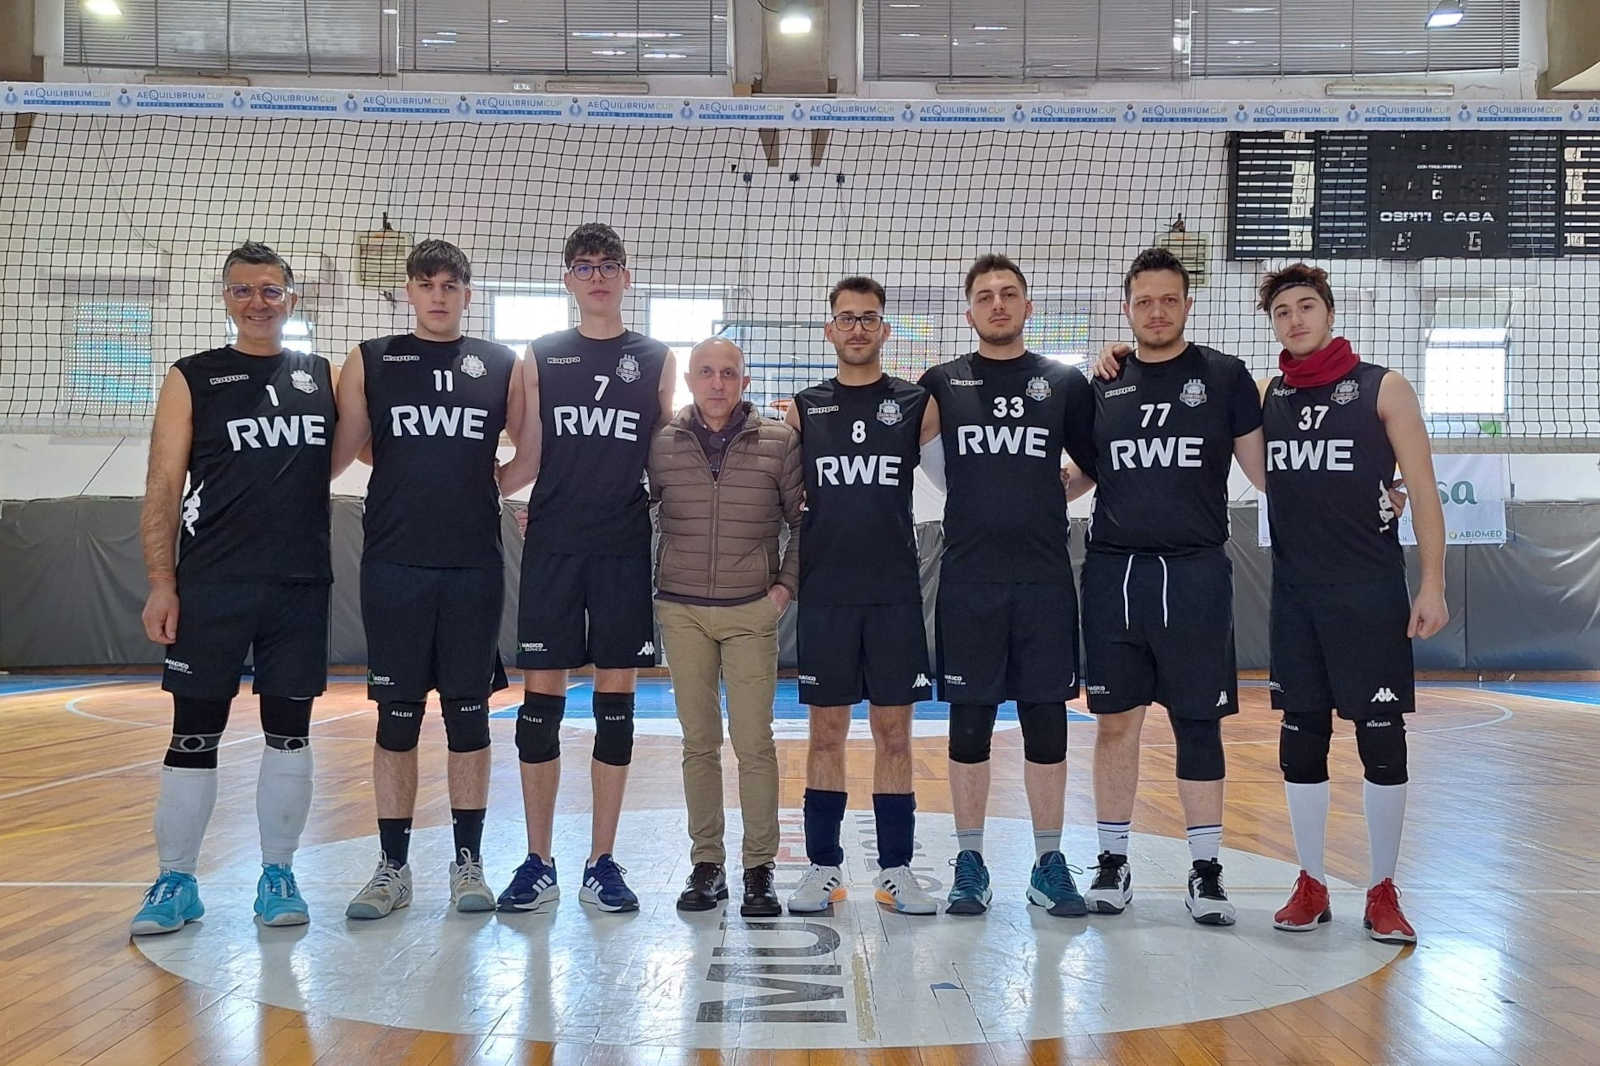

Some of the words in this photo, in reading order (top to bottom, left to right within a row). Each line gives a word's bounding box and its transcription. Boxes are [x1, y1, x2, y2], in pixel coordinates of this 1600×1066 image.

[1443, 211, 1495, 222] CASA
[433, 369, 454, 392] 11
[594, 375, 610, 401] 7
[265, 384, 279, 406] 1
[993, 396, 1025, 418] 33
[390, 405, 488, 440] RWE
[553, 405, 640, 441] RWE
[1140, 402, 1171, 428] 77
[1298, 405, 1330, 431] 37
[226, 415, 326, 452] RWE
[851, 420, 867, 444] 8
[957, 424, 1049, 458] RWE
[1110, 437, 1204, 471] RWE
[1266, 439, 1354, 472] RWE
[816, 455, 902, 487] RWE
[1459, 530, 1503, 539] ABIOMED
